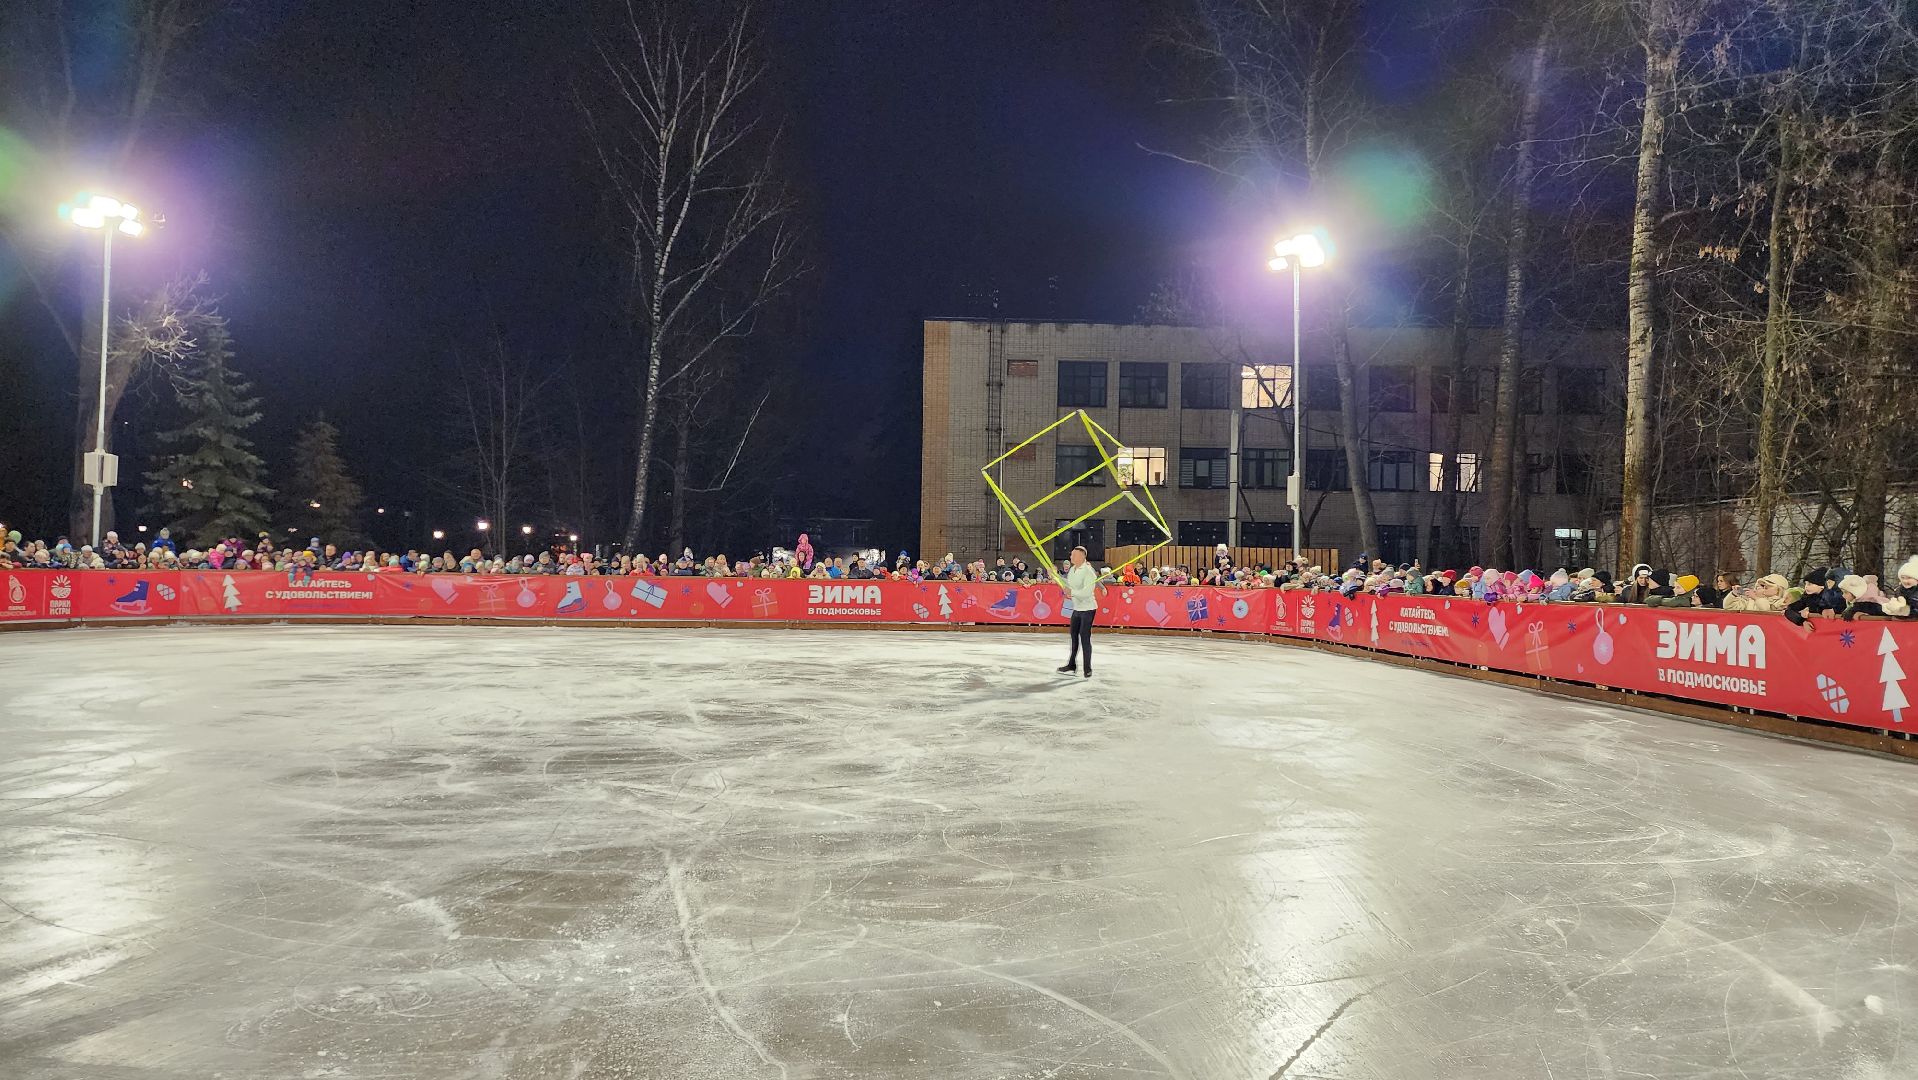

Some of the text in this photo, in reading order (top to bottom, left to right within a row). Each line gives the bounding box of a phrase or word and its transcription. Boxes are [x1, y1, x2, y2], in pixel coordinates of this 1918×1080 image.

[289, 579, 352, 588] КААЙТЕСЬ
[265, 590, 373, 600] С УДОВОЛЬСТВИЕМ!
[808, 585, 882, 604] ЗИМА
[816, 608, 882, 616] ПОДМОСКОВЬЕ
[1400, 606, 1436, 620] КАТАЙТЕСЬ
[1389, 621, 1394, 630] С
[1656, 619, 1766, 669] ЗИМА
[1658, 668, 1767, 696] В ПОДМОСКОВЬЕ
